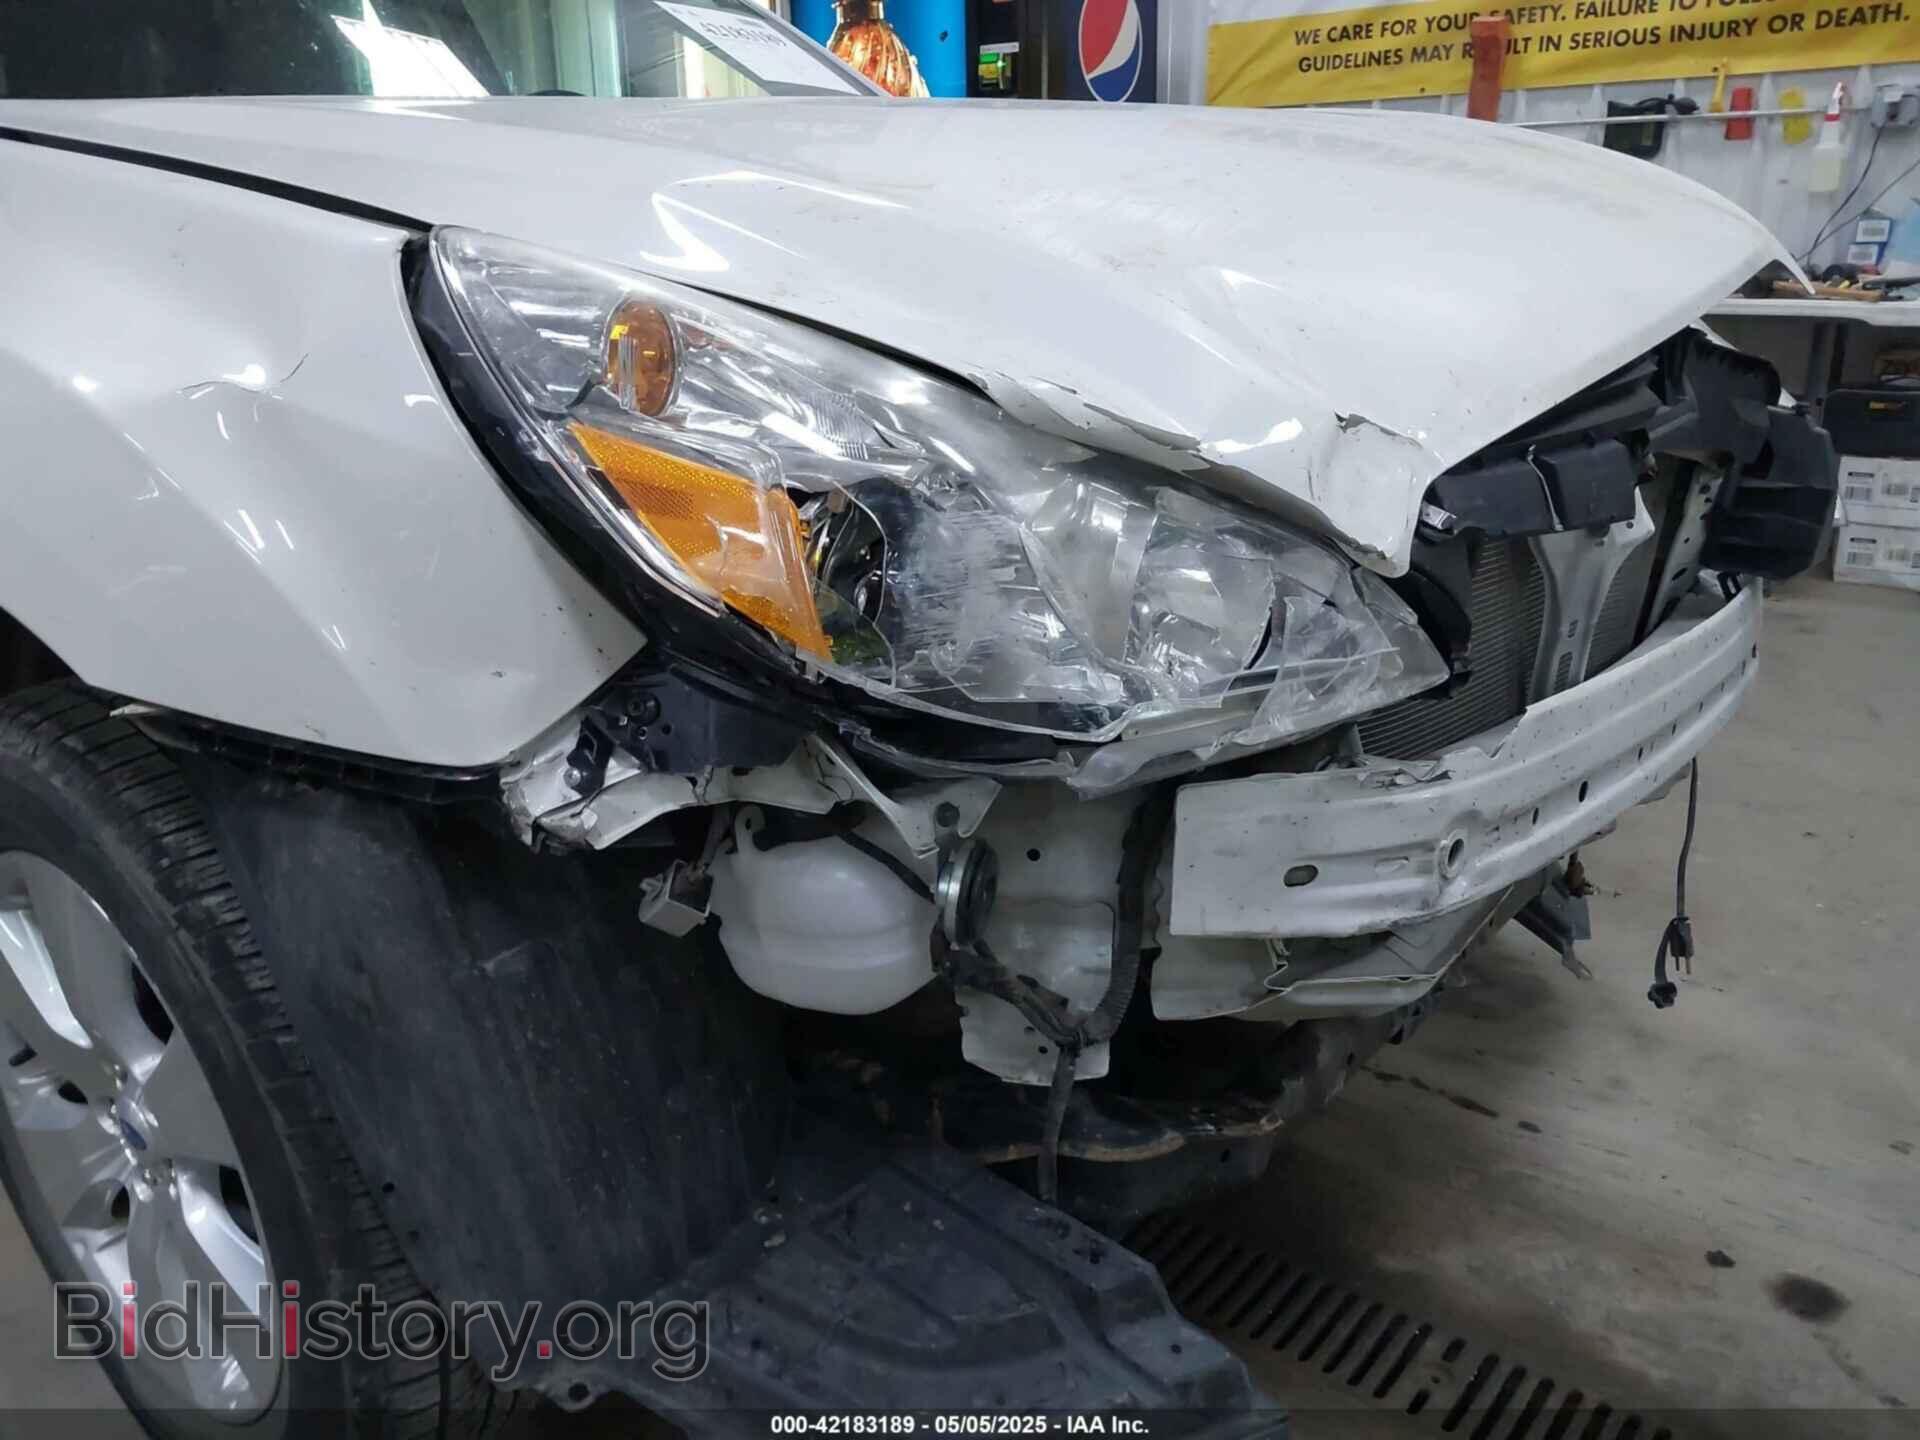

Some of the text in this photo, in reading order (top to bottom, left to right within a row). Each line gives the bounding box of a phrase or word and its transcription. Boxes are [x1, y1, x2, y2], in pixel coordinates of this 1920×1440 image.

[1295, 29, 1321, 46] WE
[1327, 23, 1374, 43] CARE
[1380, 18, 1416, 37] FOR
[1574, 0, 1659, 21] FAILURE
[1298, 48, 1402, 73] GUIDELINES
[1410, 43, 1454, 63] MAY
[1538, 34, 1562, 52] IN
[1568, 26, 1661, 51] SERIOUS
[1669, 17, 1758, 43] INJURY
[1767, 14, 1805, 34] OR
[1815, 3, 1910, 30] DEATH.
